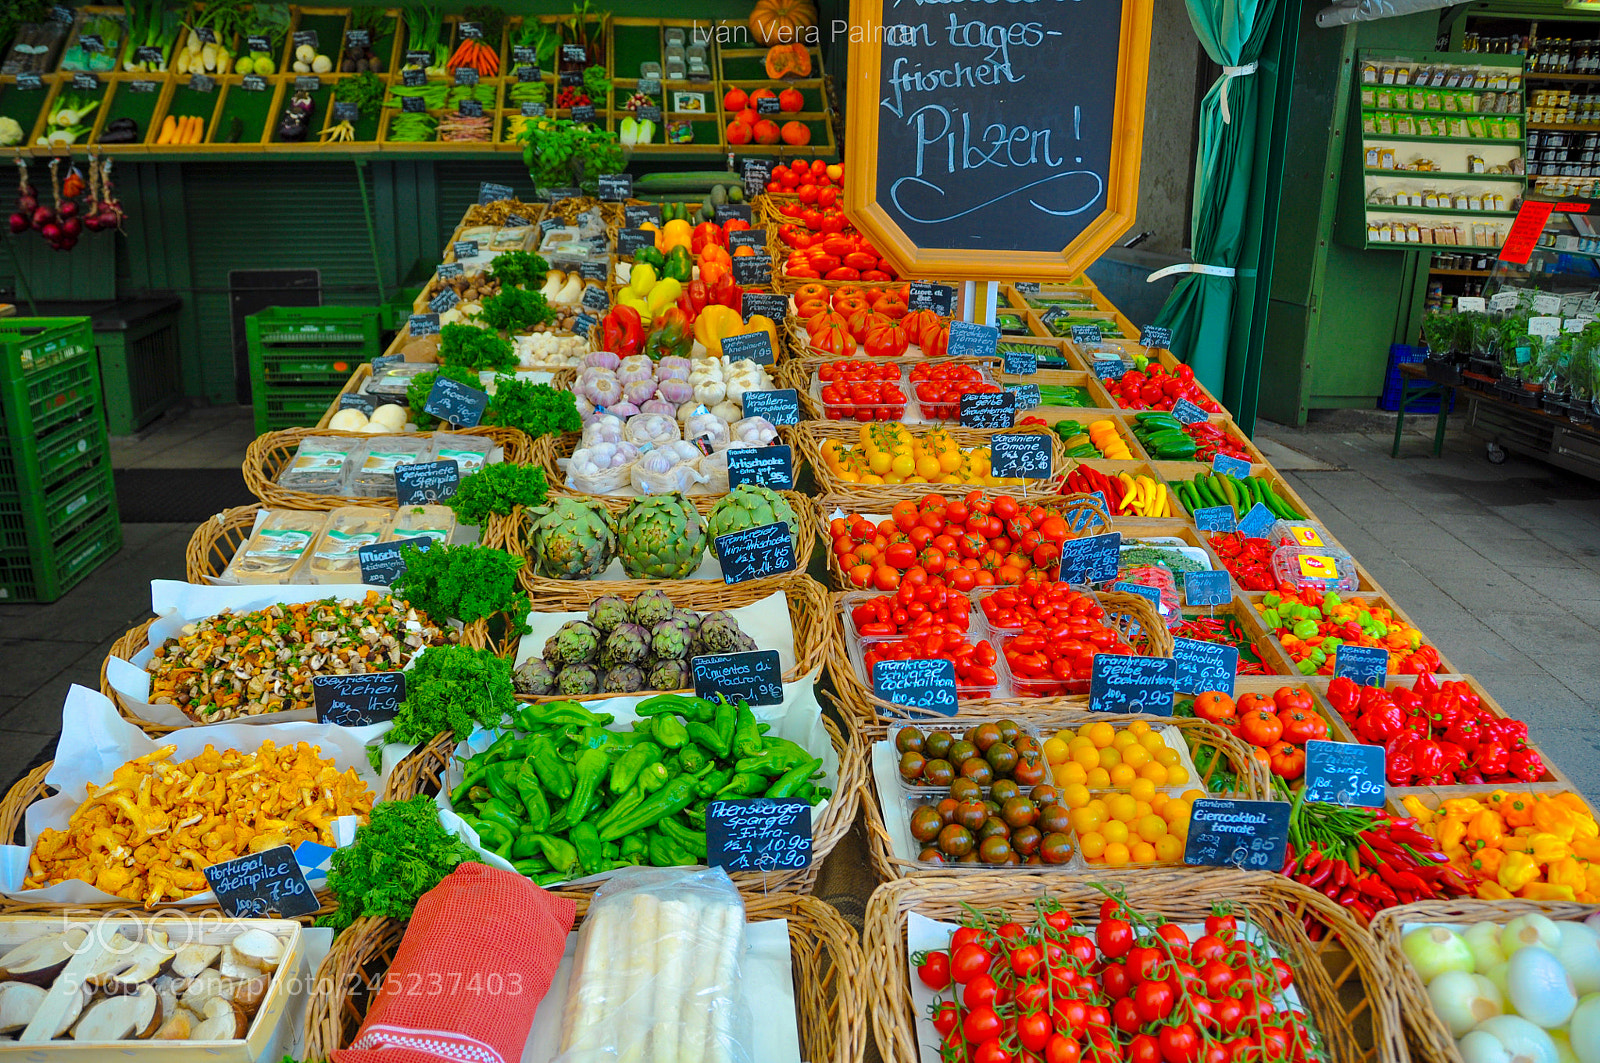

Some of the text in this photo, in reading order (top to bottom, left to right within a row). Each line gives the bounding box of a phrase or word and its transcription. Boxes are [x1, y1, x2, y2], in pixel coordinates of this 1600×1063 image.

[887, 12, 1063, 68] an tages-
[881, 57, 1025, 118] frischen
[210, 855, 264, 881] Portugal
[216, 862, 291, 894] Steinpilze
